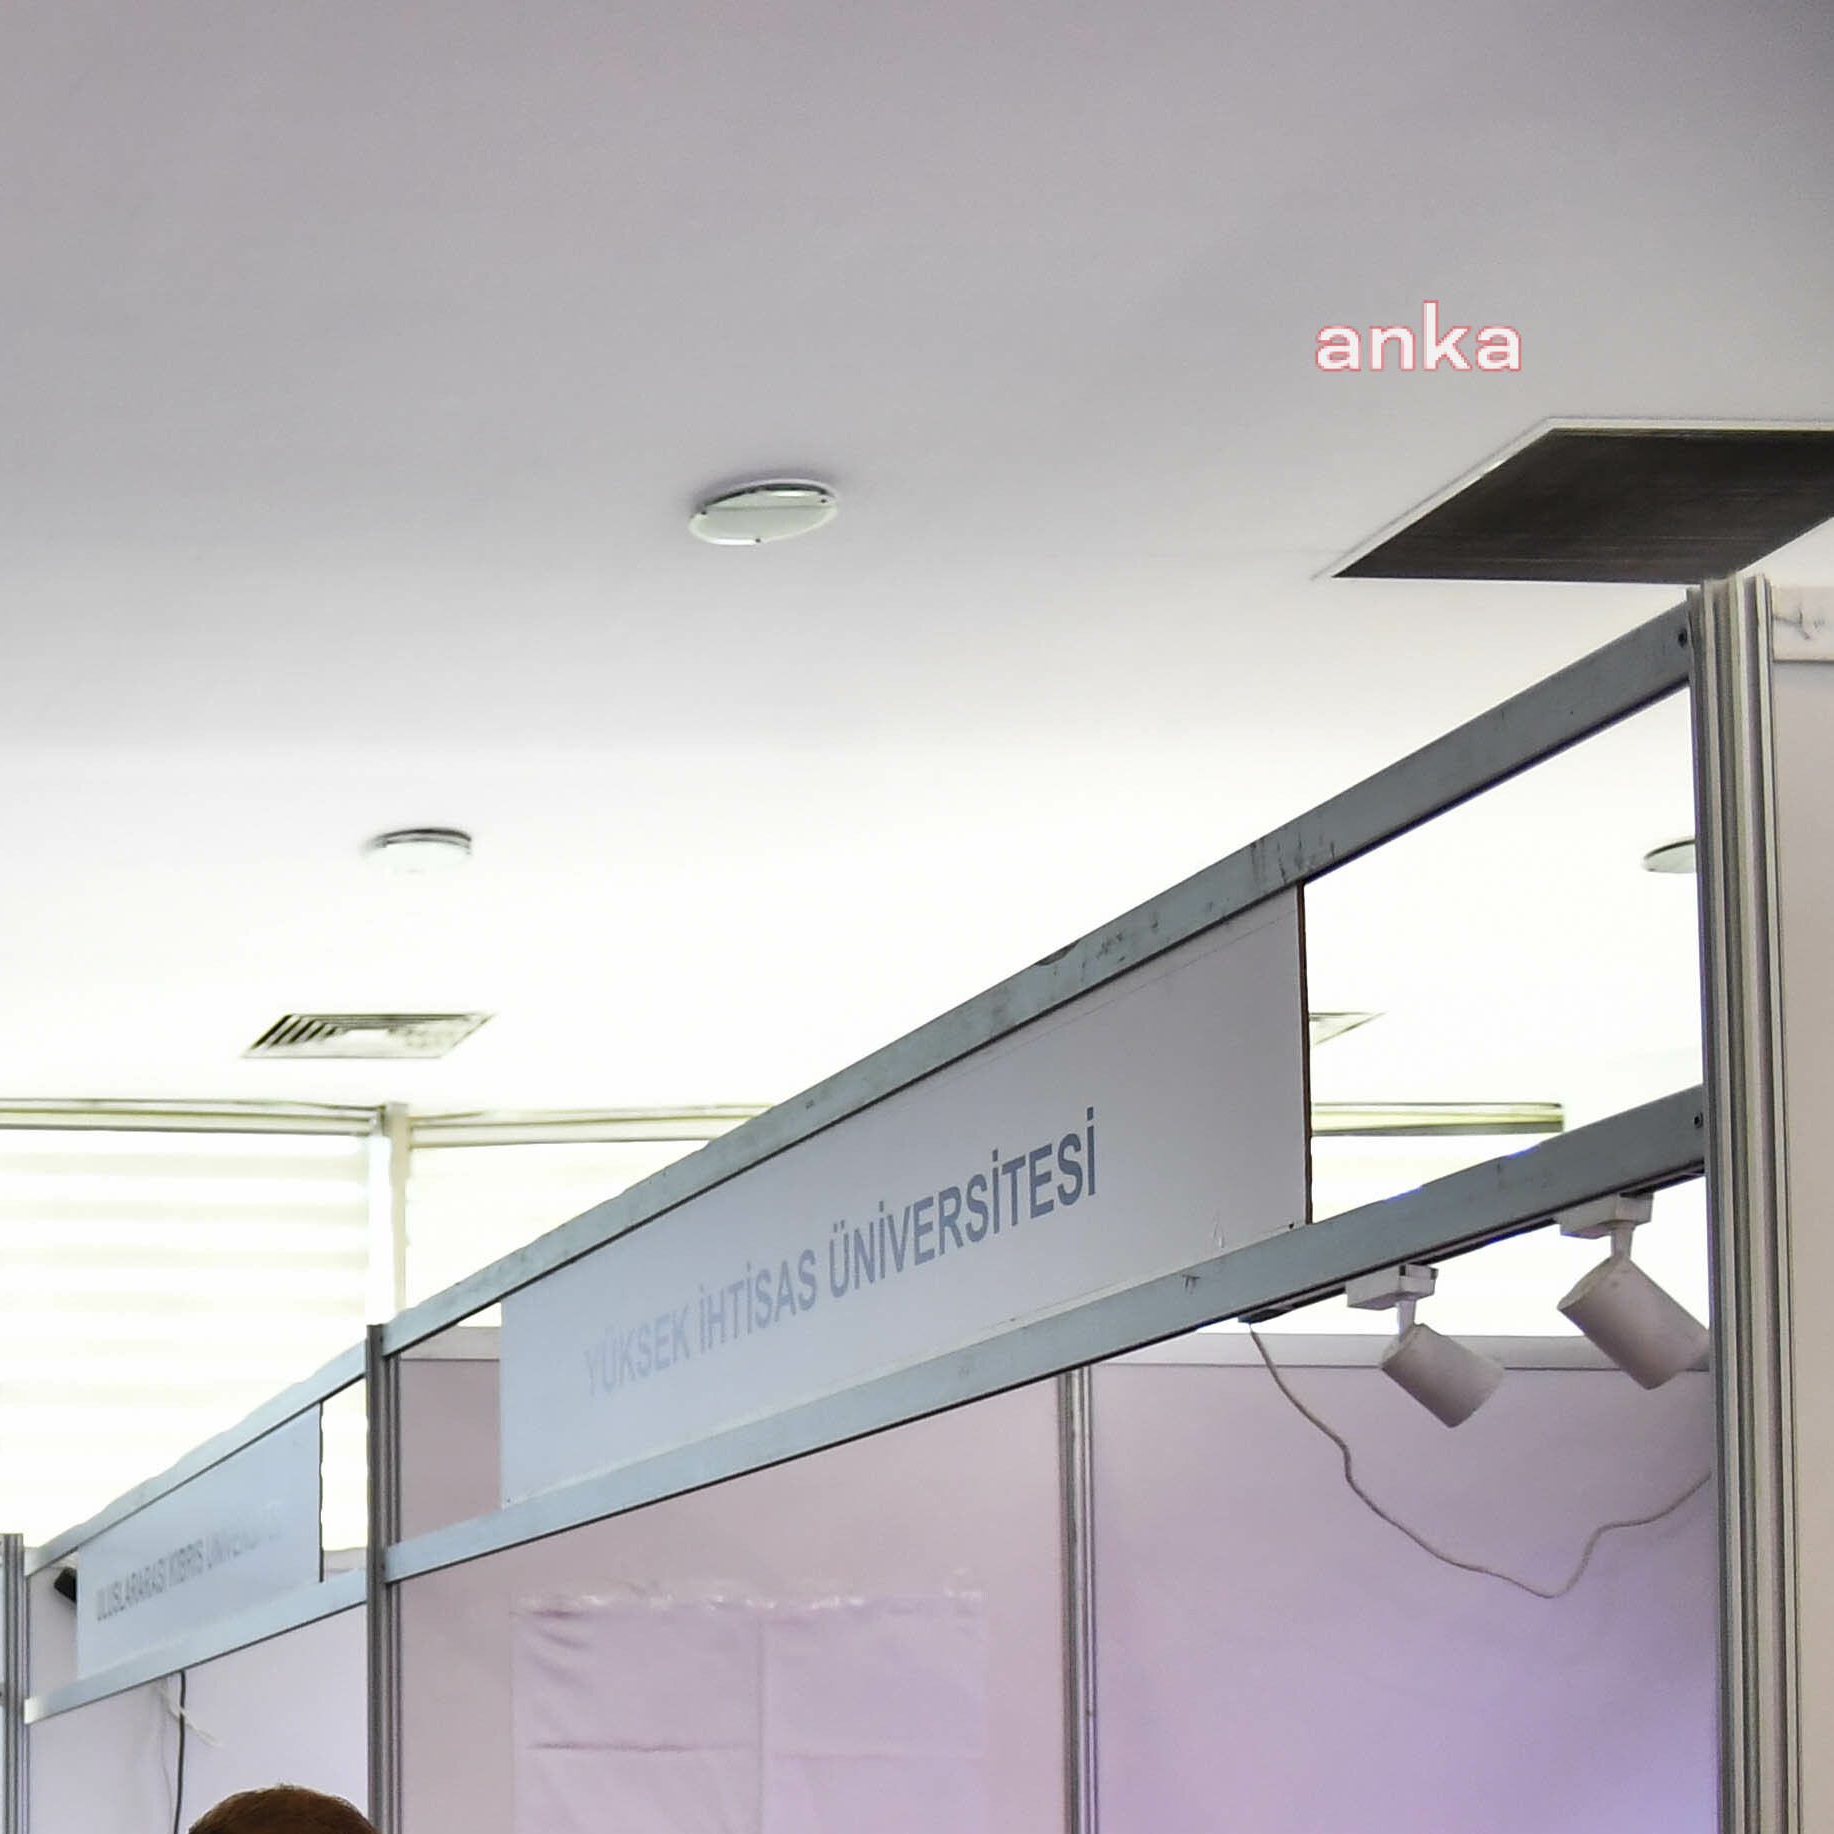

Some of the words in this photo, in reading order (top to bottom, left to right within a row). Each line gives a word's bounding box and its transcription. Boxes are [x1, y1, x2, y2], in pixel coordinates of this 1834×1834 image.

[584, 1303, 689, 1399] YÜKSEK
[698, 1249, 816, 1353] İHTİSAS
[829, 1107, 1097, 1299] ÜNİVERSİTESİ
